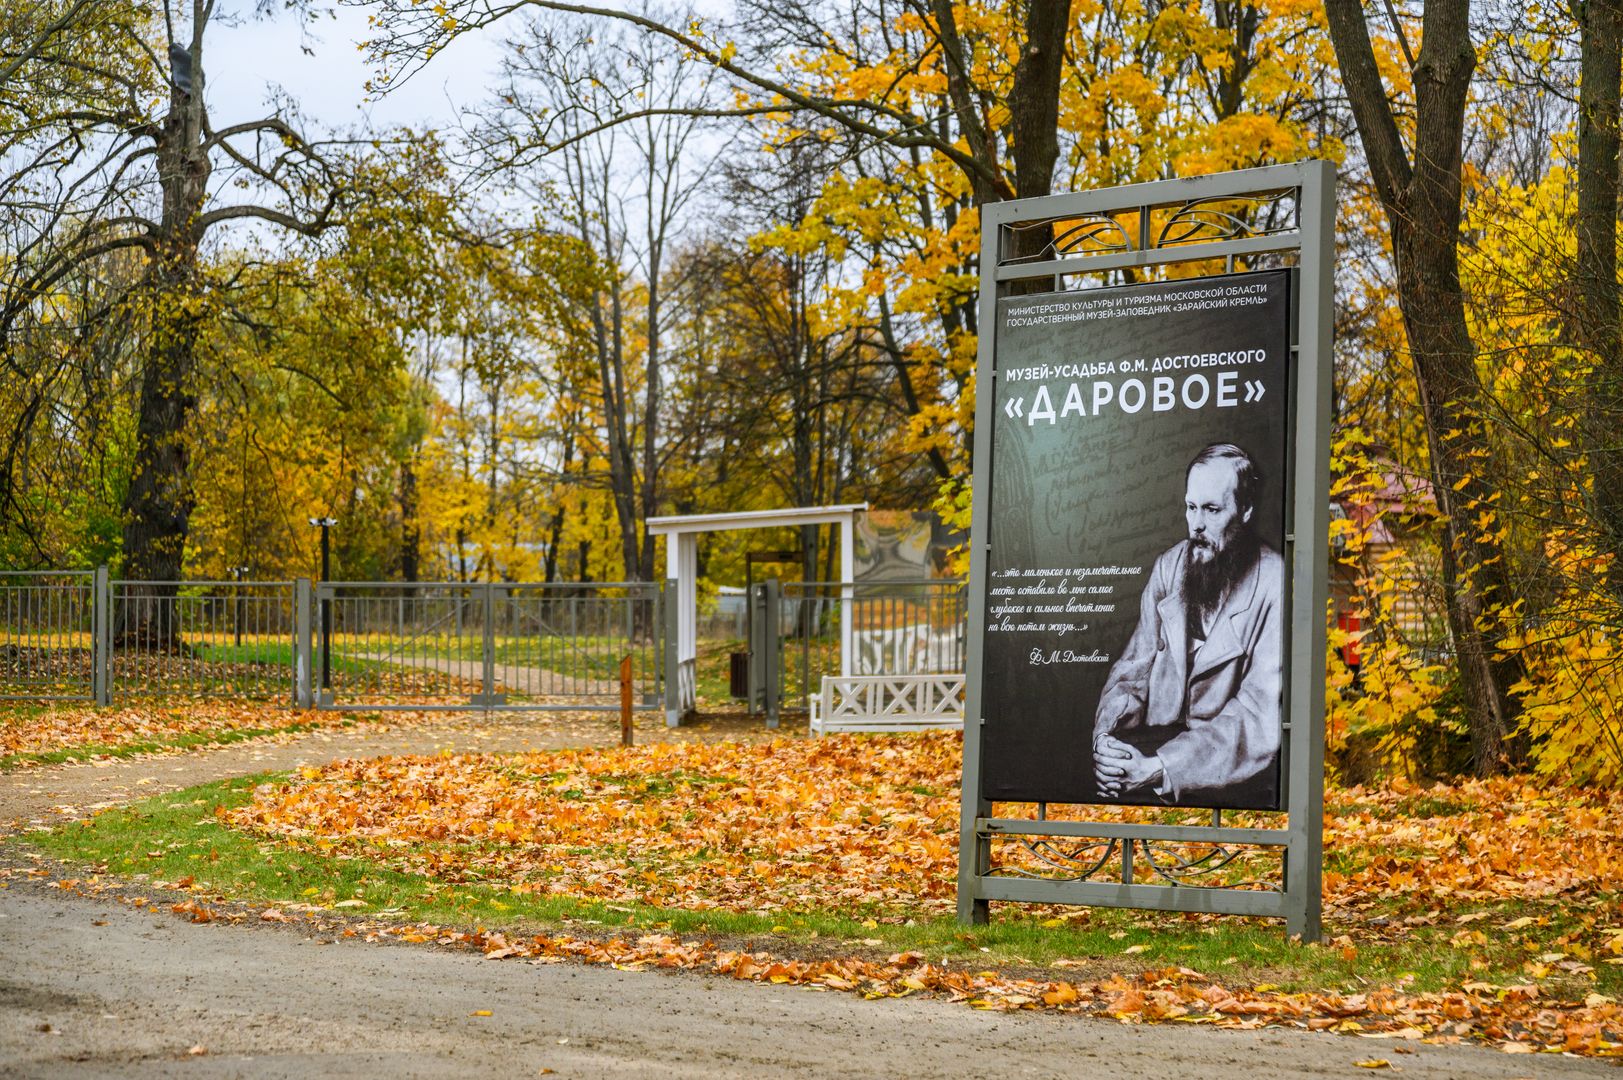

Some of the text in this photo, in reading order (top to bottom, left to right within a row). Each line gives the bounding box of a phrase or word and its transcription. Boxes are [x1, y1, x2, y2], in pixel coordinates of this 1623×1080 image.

[1008, 303, 1070, 316] МИНИСТЕРСТВО
[1072, 299, 1114, 310] КУЛЬТУРЫ
[1124, 294, 1162, 305] ТУРИЗМА
[1164, 287, 1223, 301] МОСКОВСКОЙ
[1226, 284, 1267, 296] ОБЛАСТИ
[1007, 295, 1267, 327] ГОСУДАРСТВЕННЫЙ МУЗЕЙ-ЗАПОВЕДНИК «ЗАРАЙСКИЙ КРЕМЛЬ»
[1006, 349, 1266, 382] МУЗЕЙ-УСАДЬБА Ф.М. ДОСТОЕВСКОГО
[1004, 371, 1266, 426] «ДАРОВОЕ»
[1022, 568, 1063, 577] маленькое
[1073, 566, 1142, 581] незамечательное
[990, 586, 1015, 595] место
[1017, 579, 1054, 594] оставило
[1057, 579, 1068, 594] во
[1088, 585, 1113, 594] самое
[990, 598, 1024, 618] глубокое
[1034, 605, 1063, 613] сильное
[1065, 597, 1115, 612] впечатление
[1000, 616, 1015, 631] всю
[1017, 622, 1046, 631] потом
[1063, 649, 1109, 663] Достоевский
